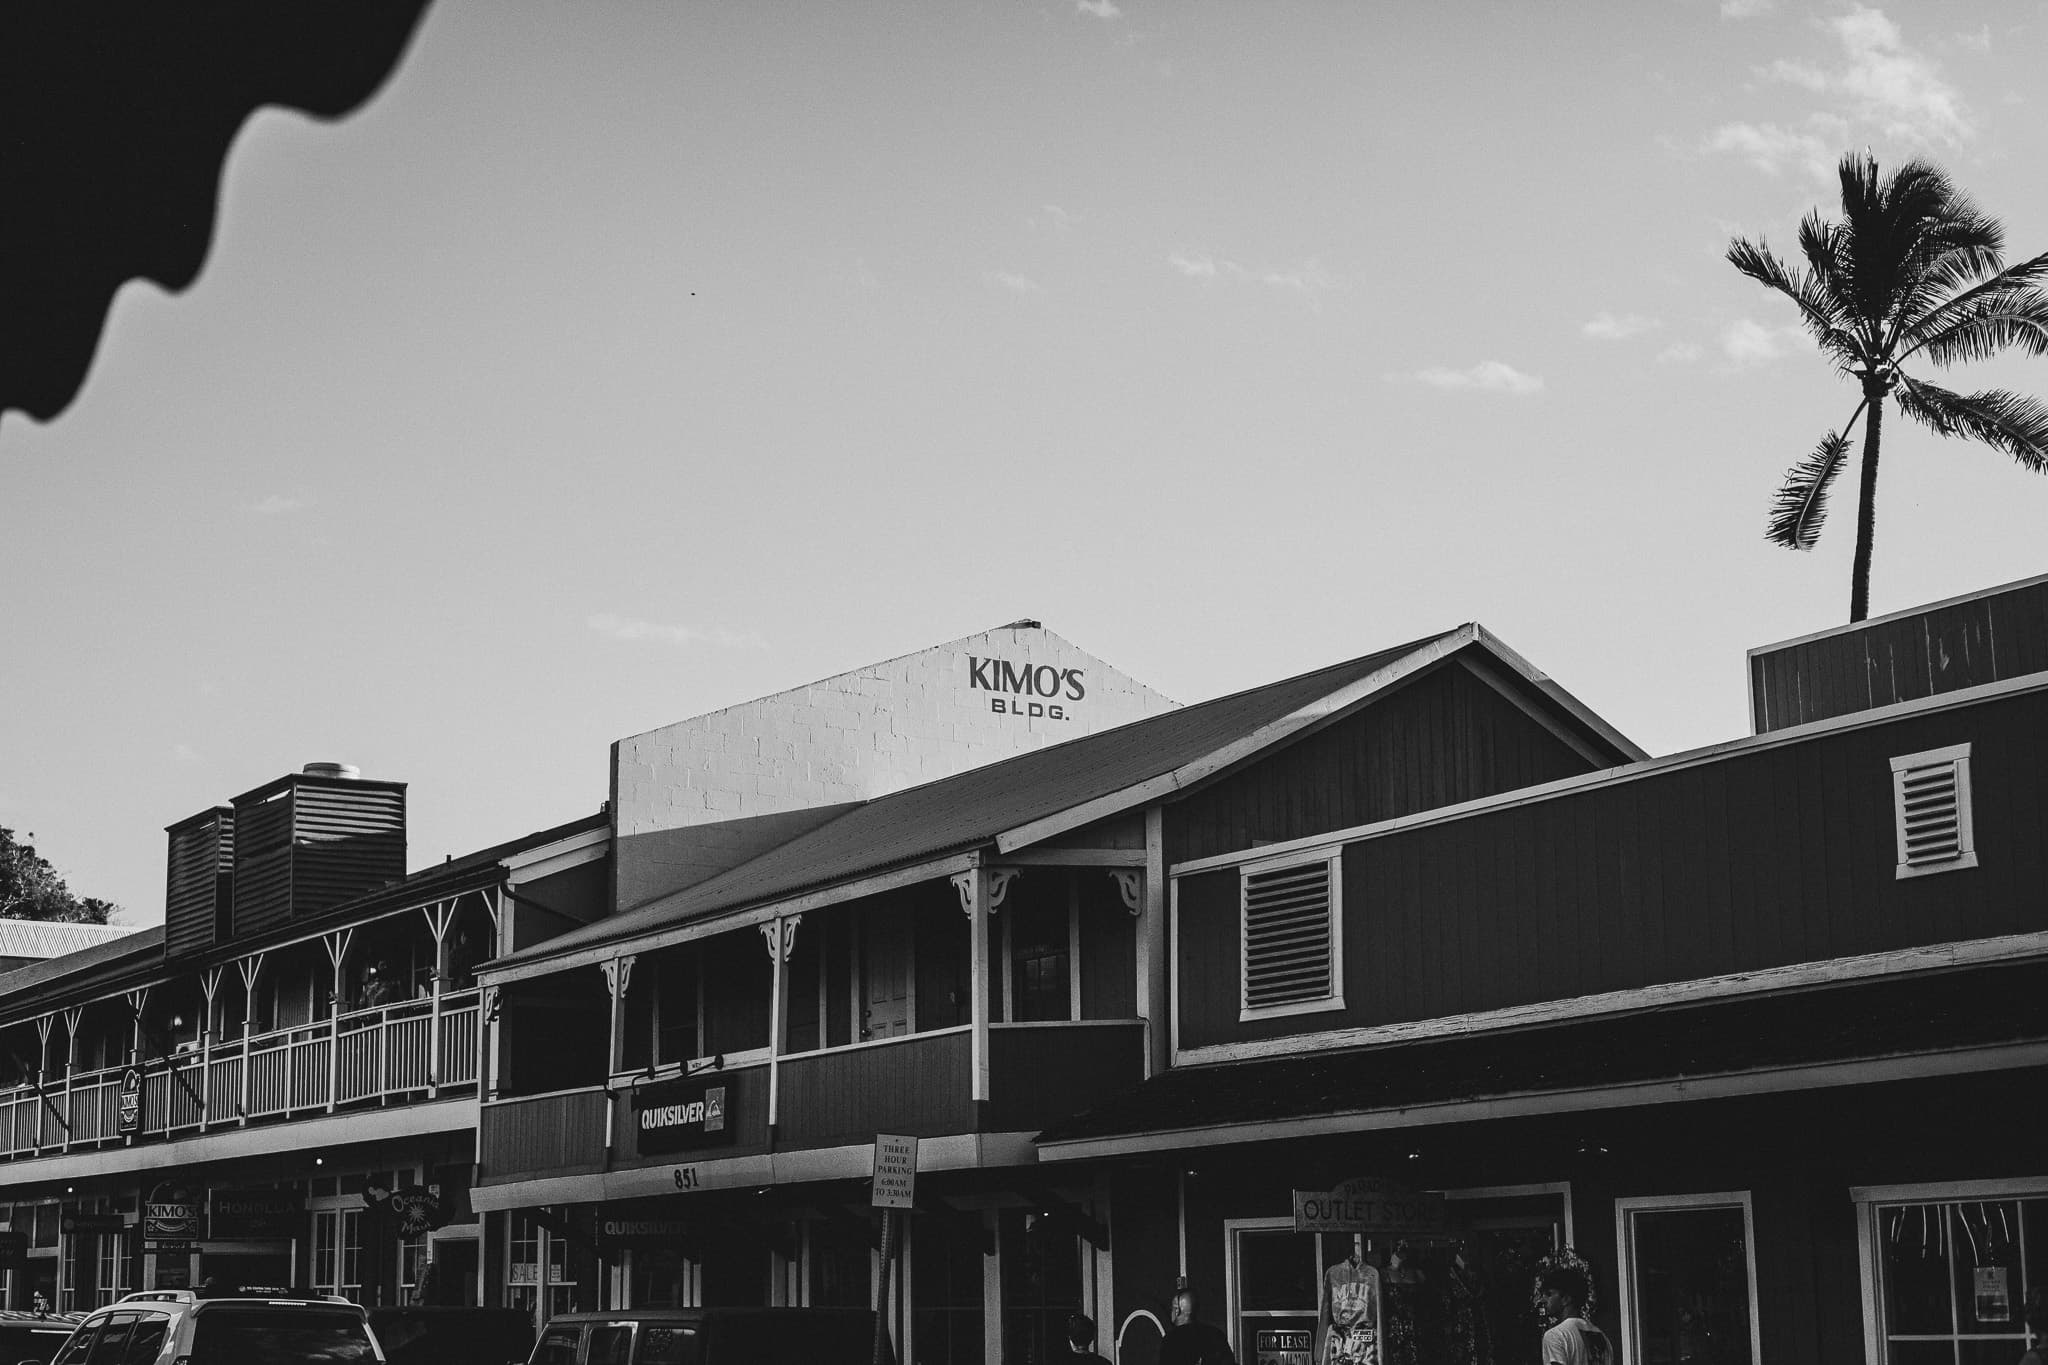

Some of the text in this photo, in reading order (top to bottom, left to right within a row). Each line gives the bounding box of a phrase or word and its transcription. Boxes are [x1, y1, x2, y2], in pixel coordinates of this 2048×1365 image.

[969, 656, 1085, 701] KIMO'S
[991, 698, 1070, 721] BLDG.
[641, 1101, 704, 1130] QUIKSILVER
[883, 1145, 910, 1154] THREE
[884, 1155, 907, 1164] HOUR
[674, 1167, 699, 1190] 851
[878, 1165, 913, 1175] PARKING
[876, 1188, 885, 1196] TO
[1304, 1200, 1376, 1221] OUTLET
[1260, 1335, 1310, 1349] FOR LEASE
